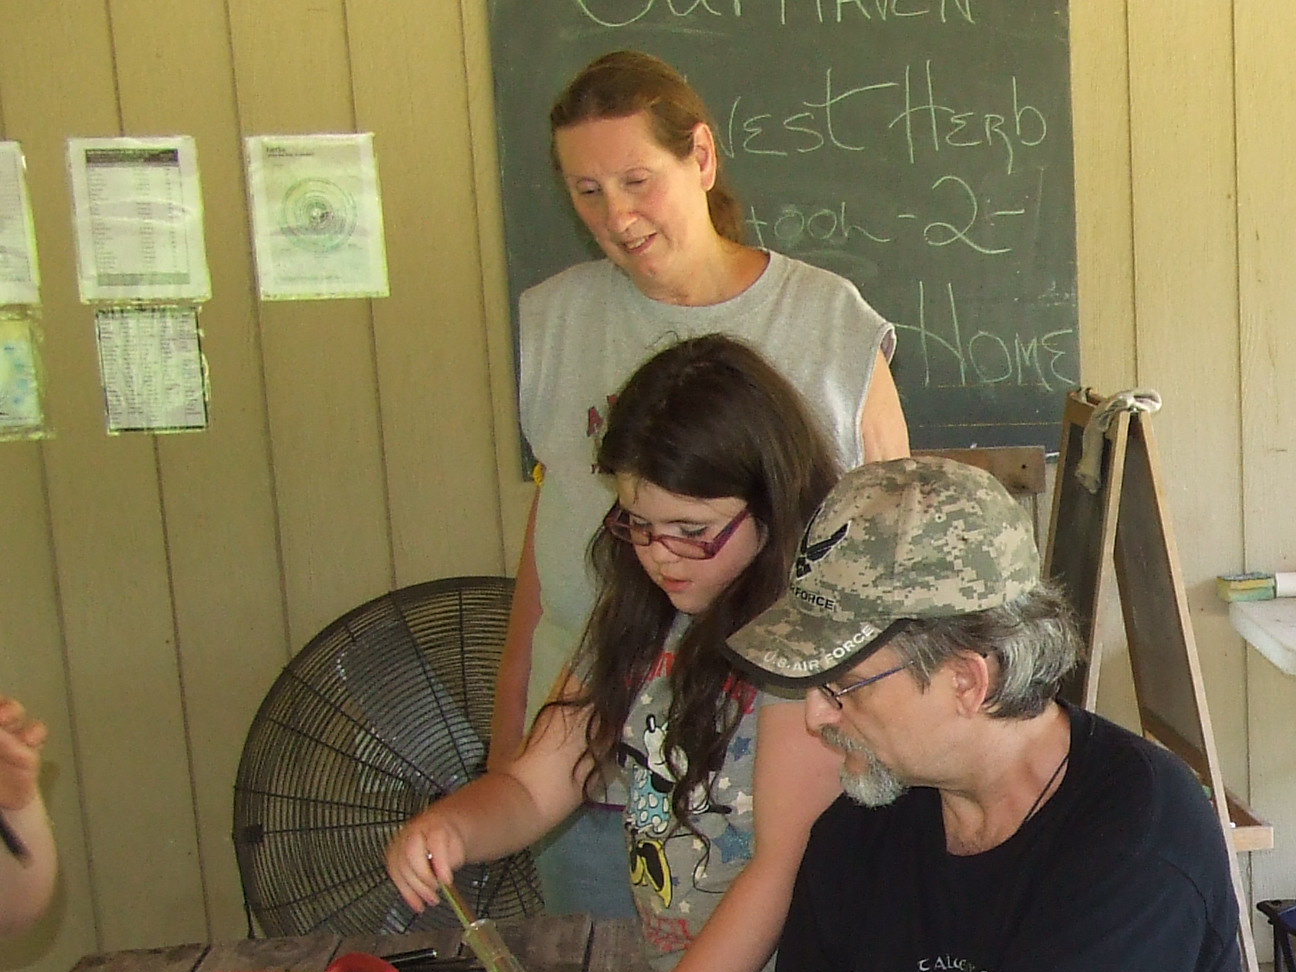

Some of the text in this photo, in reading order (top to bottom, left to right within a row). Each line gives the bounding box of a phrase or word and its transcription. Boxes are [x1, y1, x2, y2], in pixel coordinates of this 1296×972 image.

[795, 587, 834, 610] FORCE
[793, 659, 820, 672] AIR
[824, 624, 875, 664] FORCE
